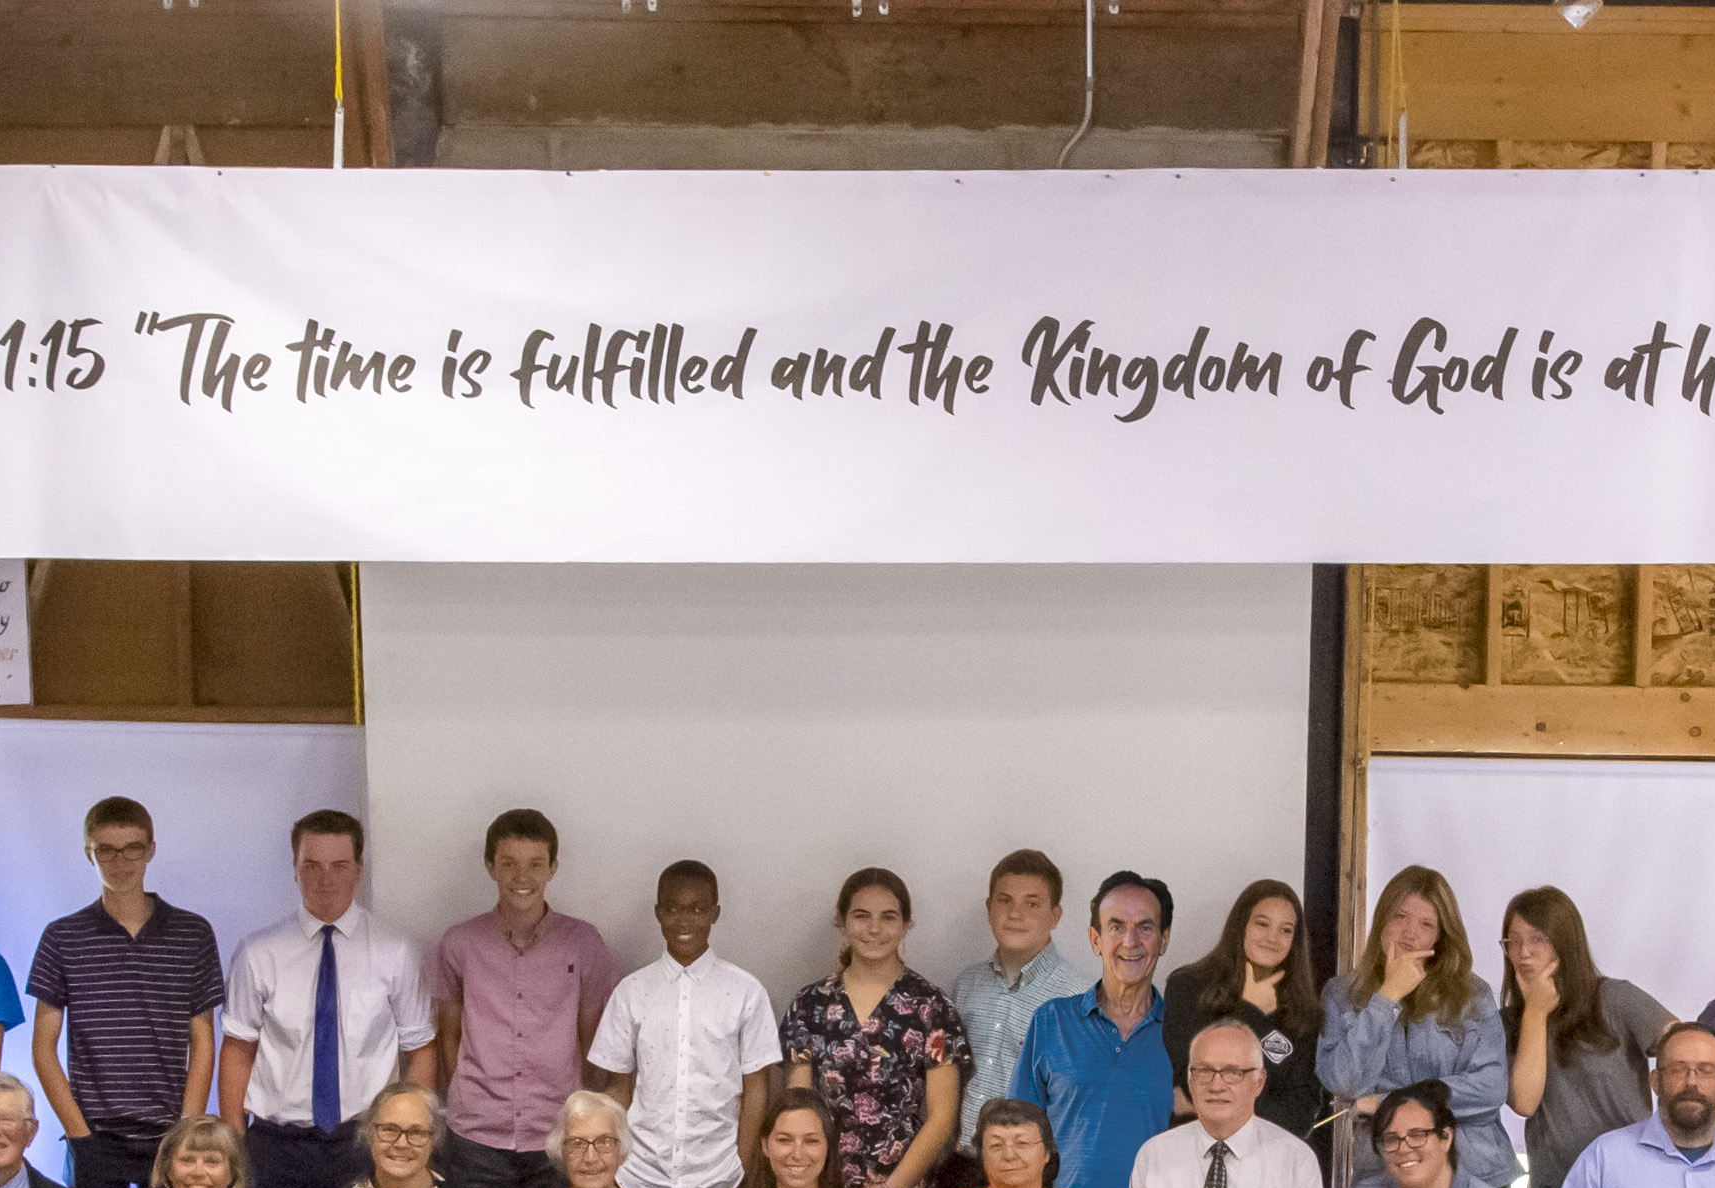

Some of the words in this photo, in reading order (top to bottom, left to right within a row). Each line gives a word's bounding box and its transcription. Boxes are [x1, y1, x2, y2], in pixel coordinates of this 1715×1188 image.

[134, 311, 271, 413] "The
[285, 318, 416, 404] time
[441, 328, 491, 399] is
[509, 322, 758, 410] fulfilled
[770, 326, 896, 401] and
[897, 319, 994, 416] the
[1021, 315, 1283, 423] Kingdom
[1306, 328, 1377, 409] of
[1386, 316, 1519, 415] God
[1531, 329, 1583, 401] is
[1603, 320, 1683, 407] at
